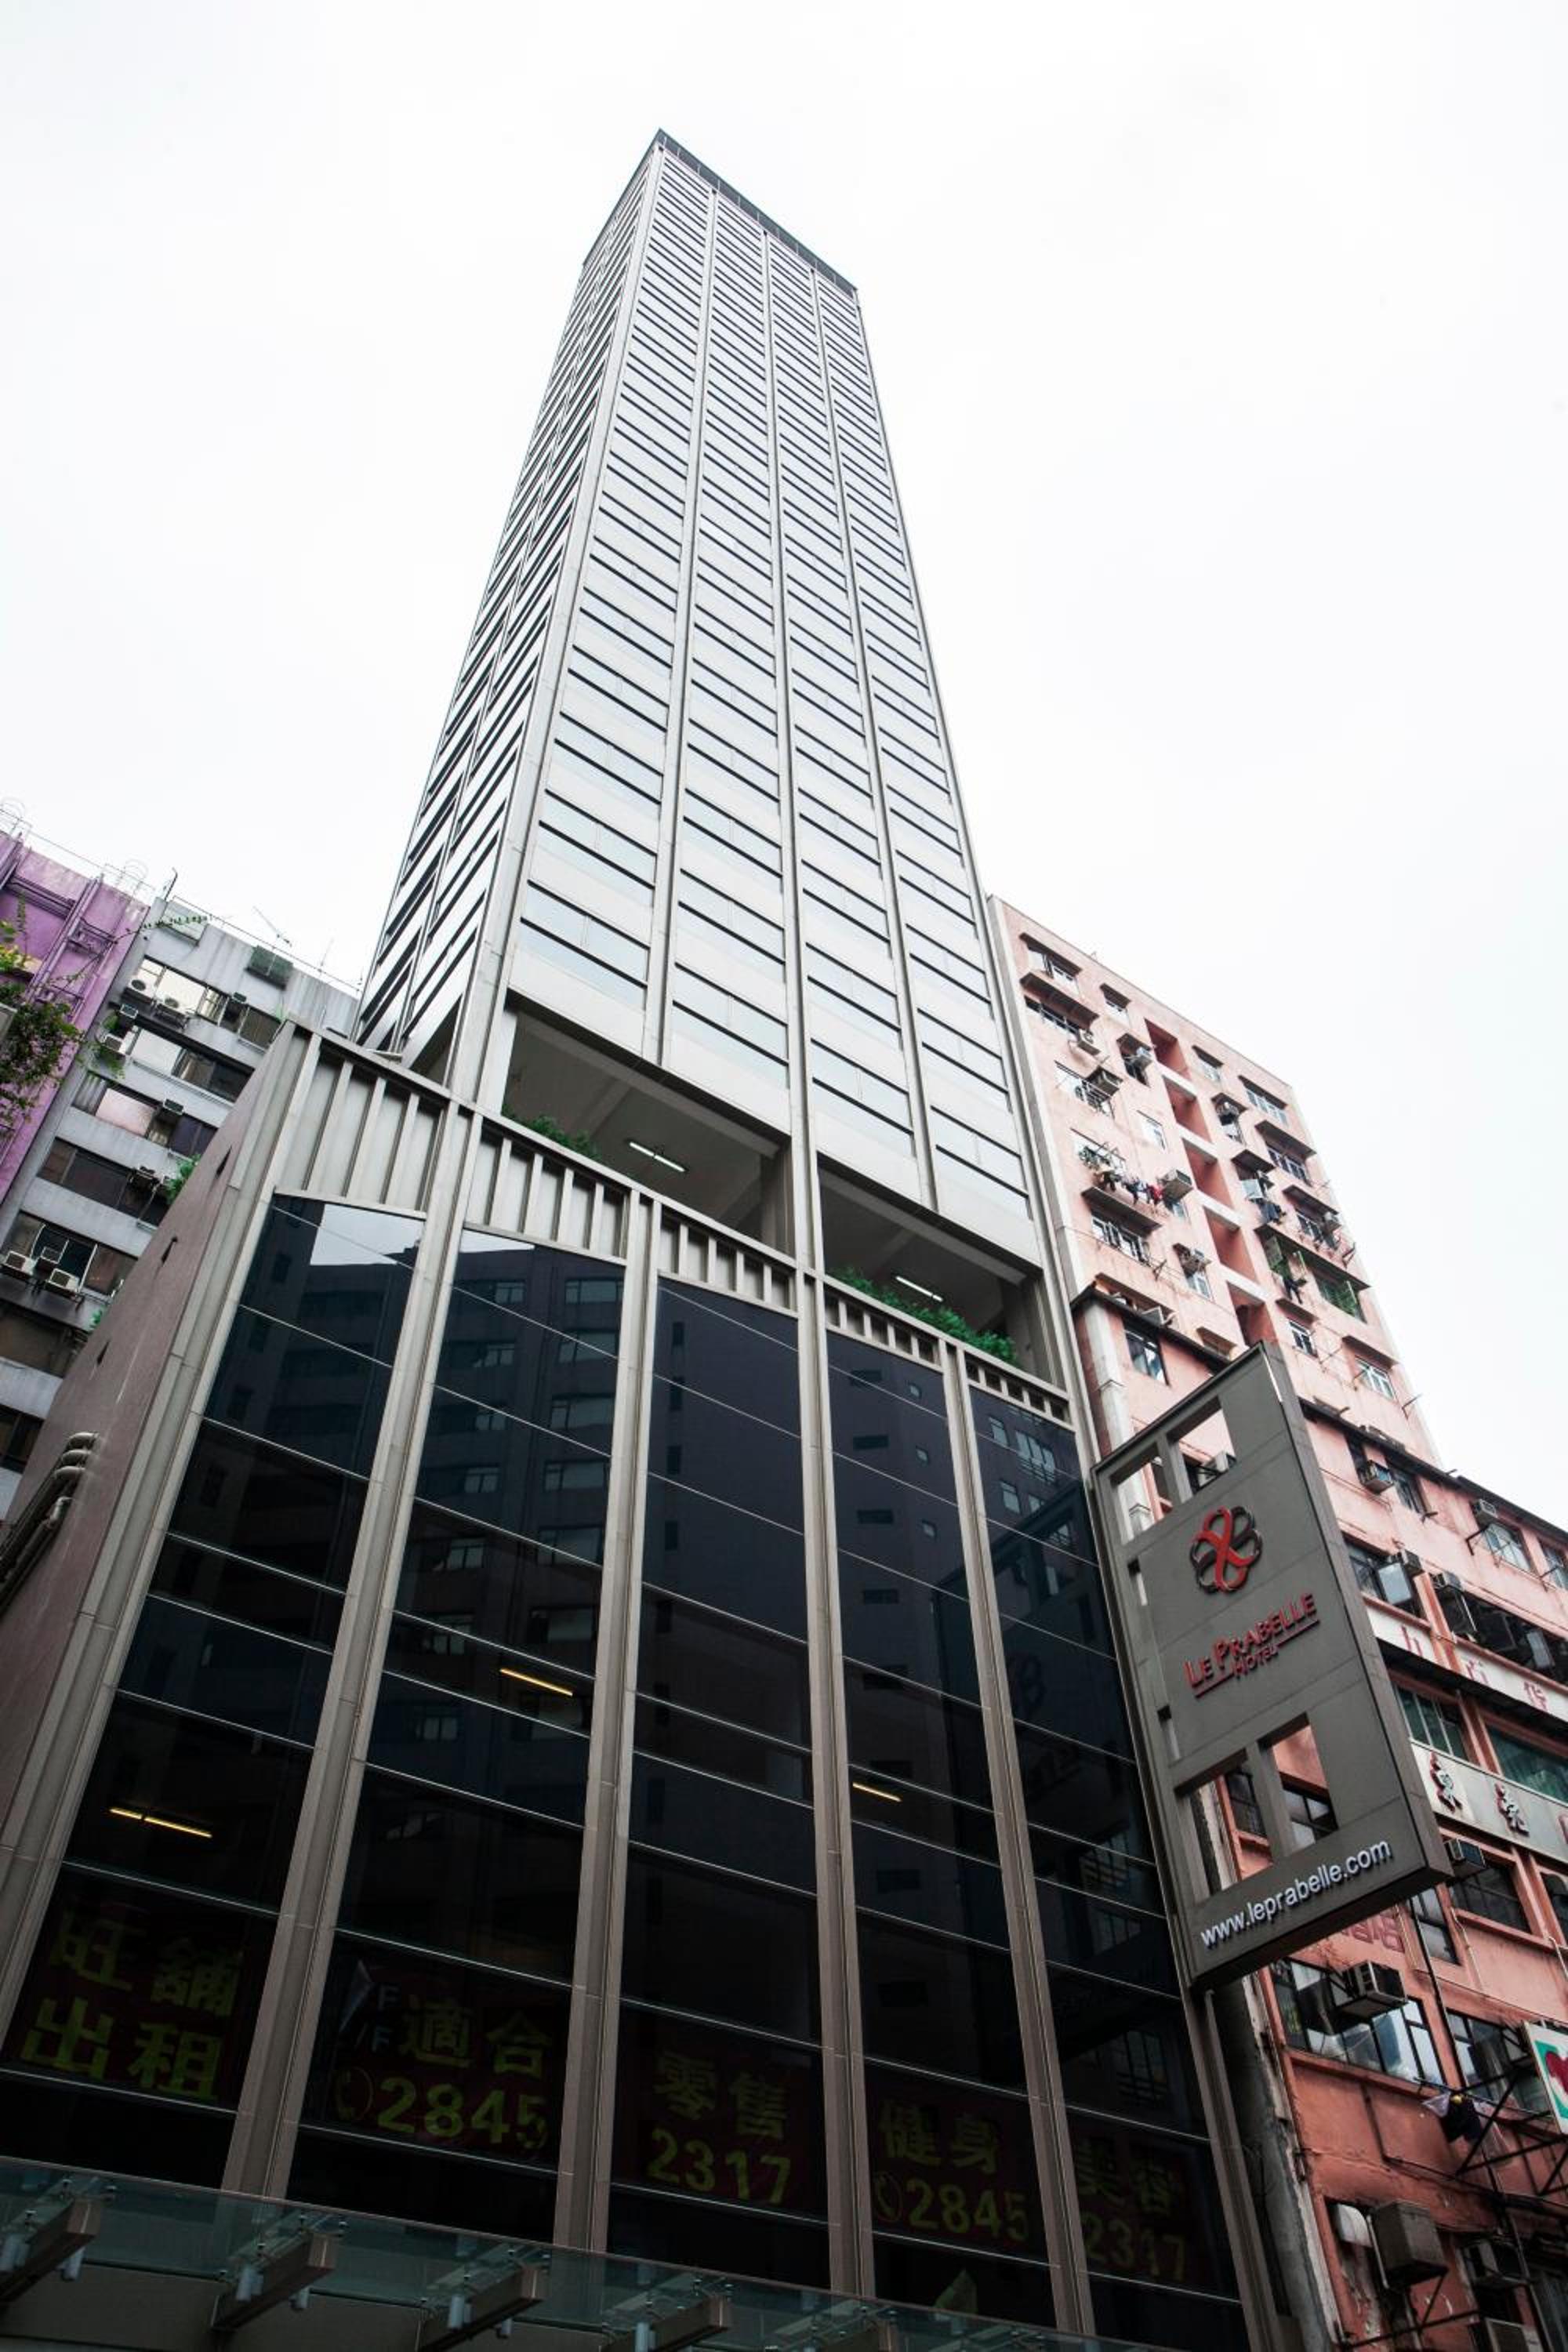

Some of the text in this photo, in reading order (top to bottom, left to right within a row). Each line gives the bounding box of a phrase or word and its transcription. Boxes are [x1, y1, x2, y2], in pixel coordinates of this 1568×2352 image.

[1183, 1593, 1318, 1689] LE PRABELLE
[1200, 1841, 1393, 1947] www.leprabelle.com
[22, 1996, 223, 2103] 出租
[376, 2074, 551, 2151] 2845
[644, 2126, 792, 2208] 2317
[904, 2176, 1029, 2242] 2845
